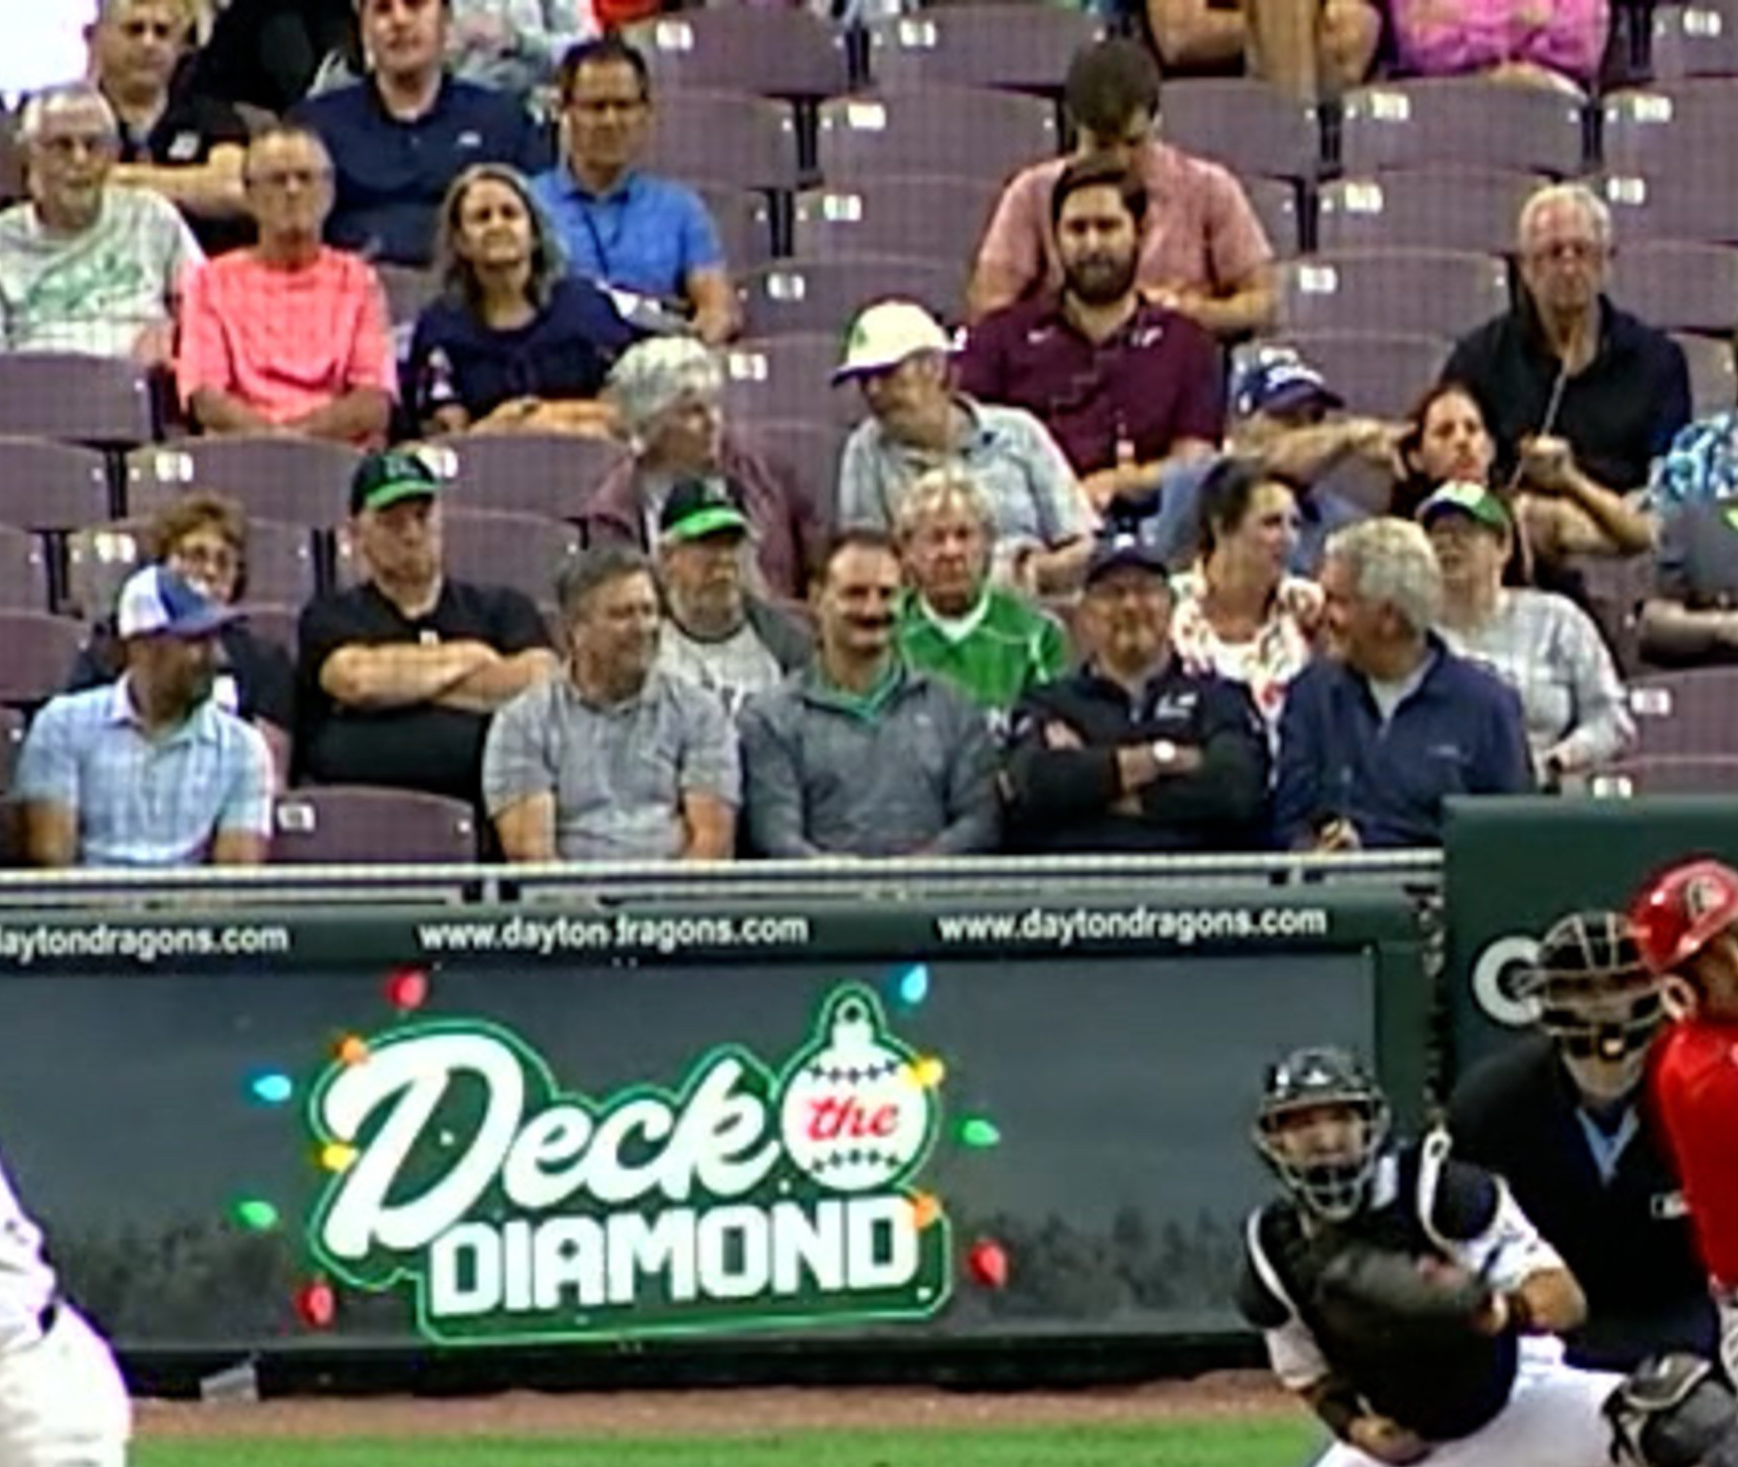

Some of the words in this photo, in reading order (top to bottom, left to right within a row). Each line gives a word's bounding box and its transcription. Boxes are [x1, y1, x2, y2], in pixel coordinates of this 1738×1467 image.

[937, 904, 1328, 946] www.daytondragons.com
[323, 1034, 782, 1259] Deck
[806, 1091, 901, 1143] the
[430, 1194, 923, 1317] DIAMOND
